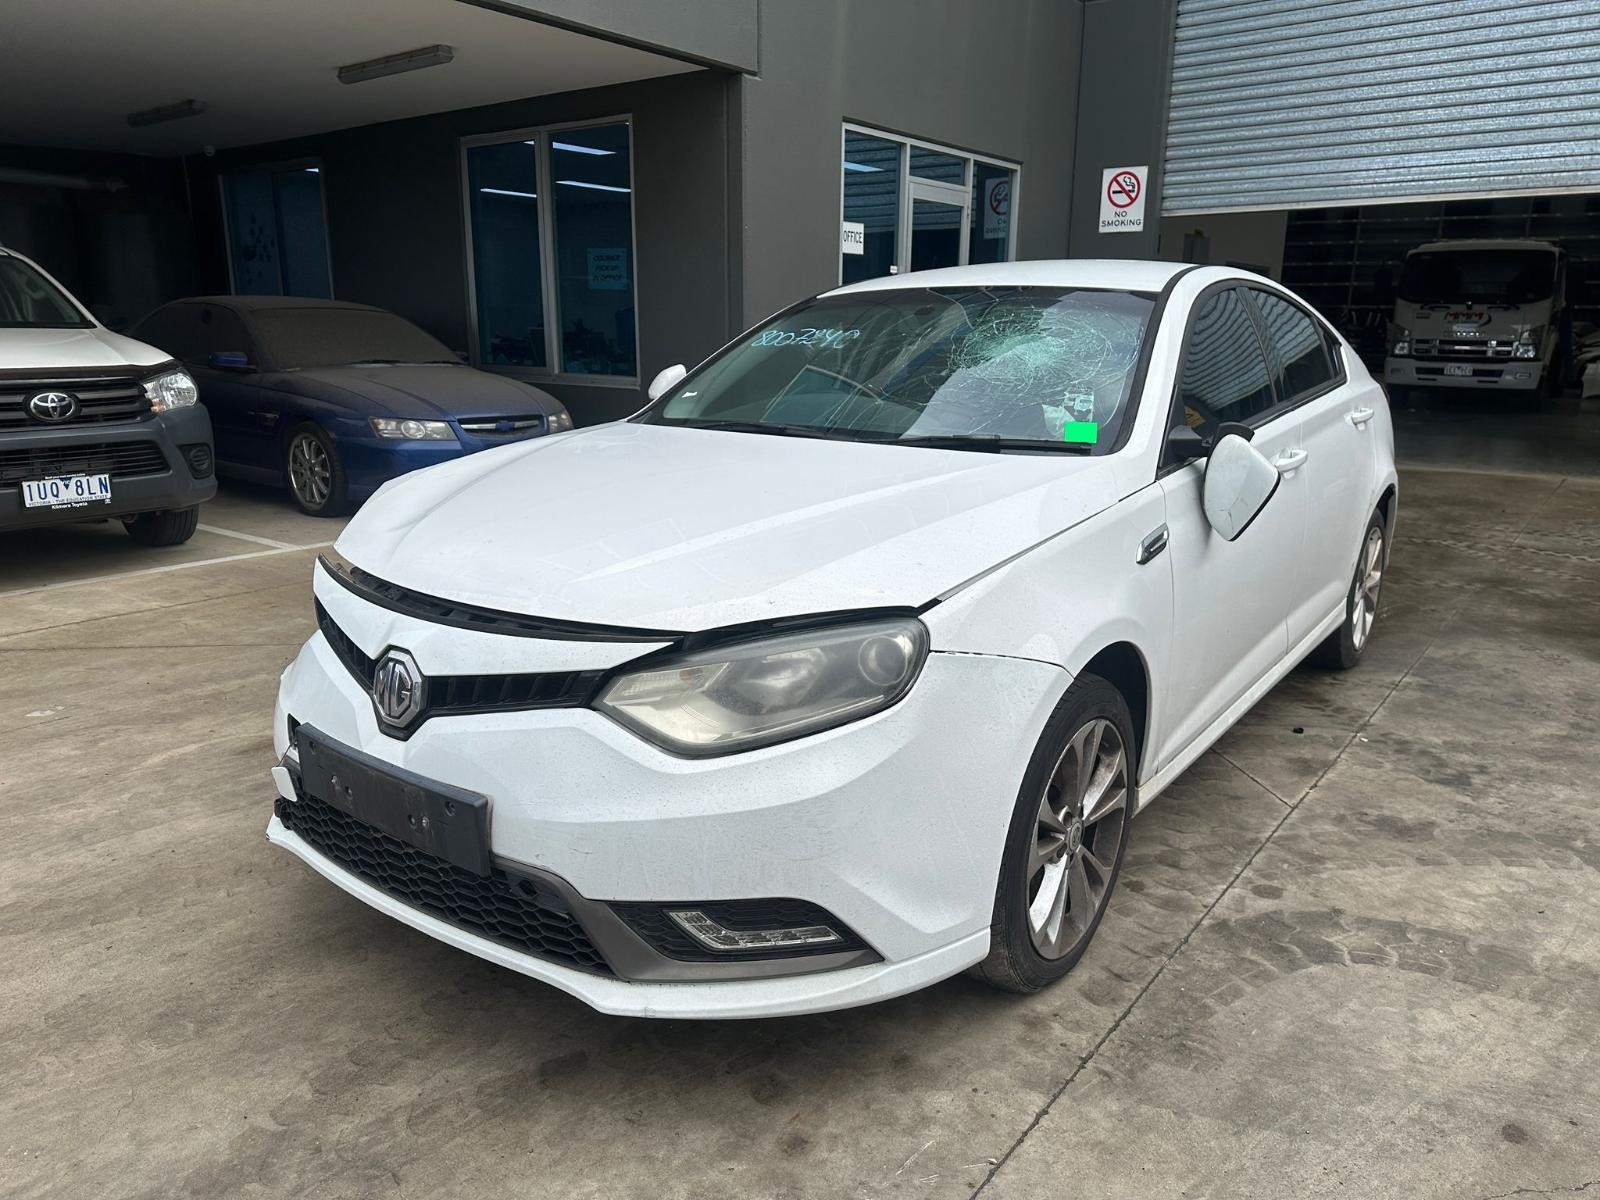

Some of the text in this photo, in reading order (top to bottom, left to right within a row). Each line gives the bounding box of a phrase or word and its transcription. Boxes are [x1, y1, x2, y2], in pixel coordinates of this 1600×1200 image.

[1101, 218, 1142, 227] SMOKING
[843, 230, 862, 244] OFFICE
[26, 476, 109, 502] 1UQ 8LN
